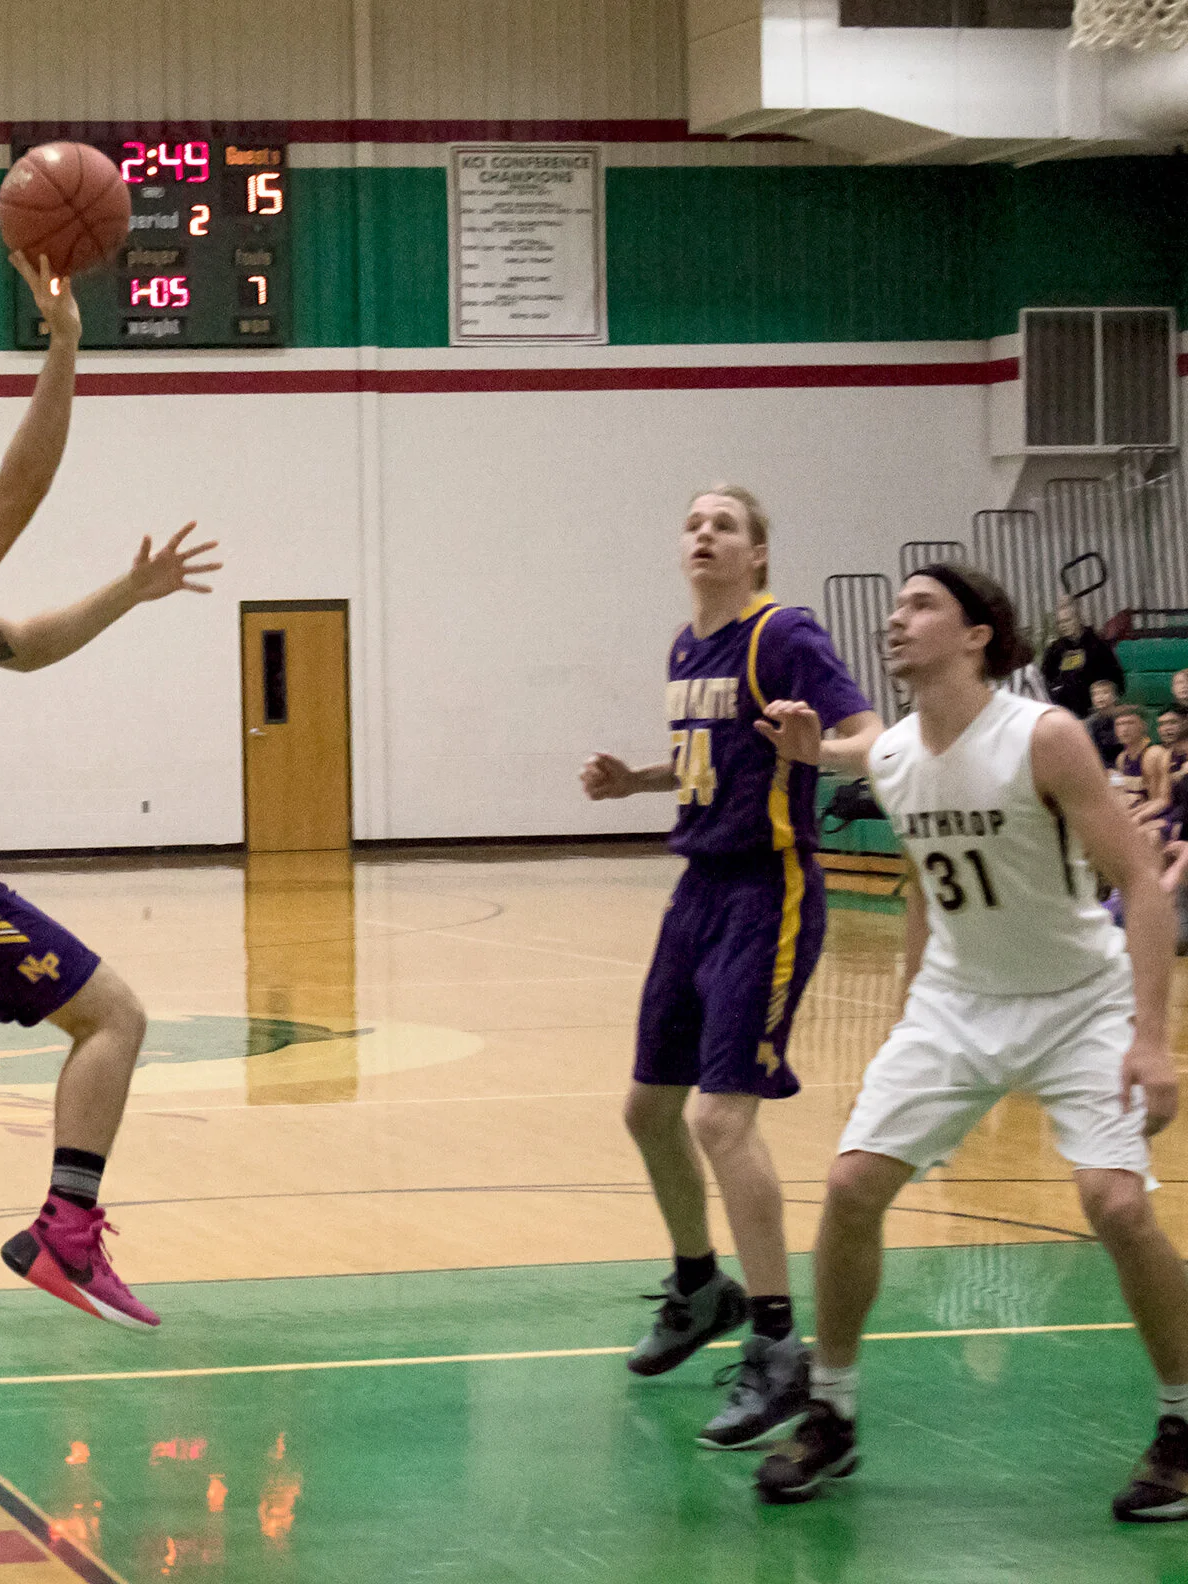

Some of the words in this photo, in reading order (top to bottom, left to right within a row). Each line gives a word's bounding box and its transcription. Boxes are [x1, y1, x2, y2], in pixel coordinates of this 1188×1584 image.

[120, 141, 210, 183] 2:49
[479, 171, 573, 183] CHAMPIONS
[490, 156, 590, 169] CONFERENCE
[247, 172, 283, 215] 15
[189, 204, 211, 236] 2
[247, 275, 267, 305] 7
[925, 850, 999, 911] 31
